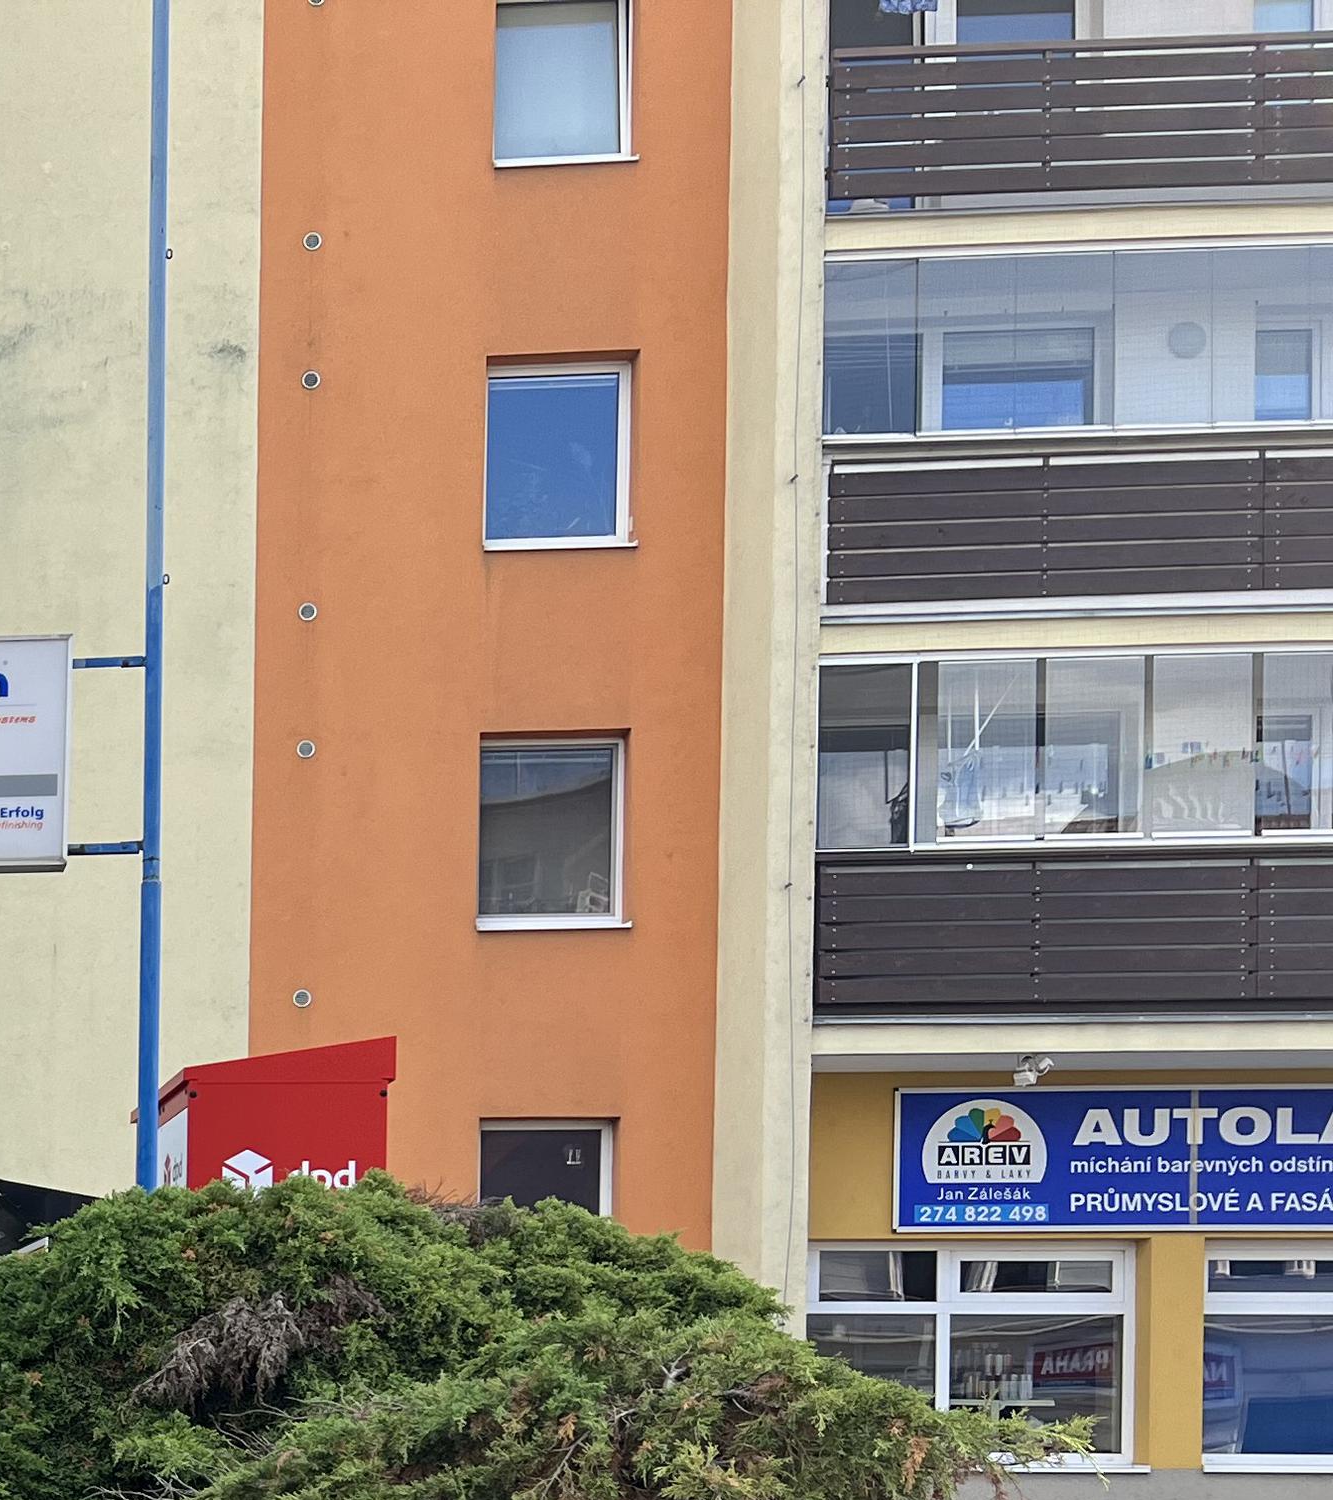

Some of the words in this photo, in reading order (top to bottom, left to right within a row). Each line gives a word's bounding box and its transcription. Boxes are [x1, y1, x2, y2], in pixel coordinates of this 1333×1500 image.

[0, 806, 44, 821] Erfolg
[937, 1145, 1031, 1166] AREV
[1070, 1154, 1151, 1174] míchání
[1157, 1154, 1263, 1178] barevných
[937, 1169, 976, 1180] BARVY
[985, 1169, 992, 1180] &
[1000, 1169, 1032, 1180] LAKY
[937, 1187, 964, 1201] Jan
[967, 1186, 1032, 1201] Zálešák
[1070, 1187, 1240, 1213] PRŮMYSLOVÉ
[1246, 1192, 1264, 1212] A
[919, 1206, 957, 1222] 274
[964, 1206, 1002, 1222] 822
[1008, 1206, 1047, 1222] 498
